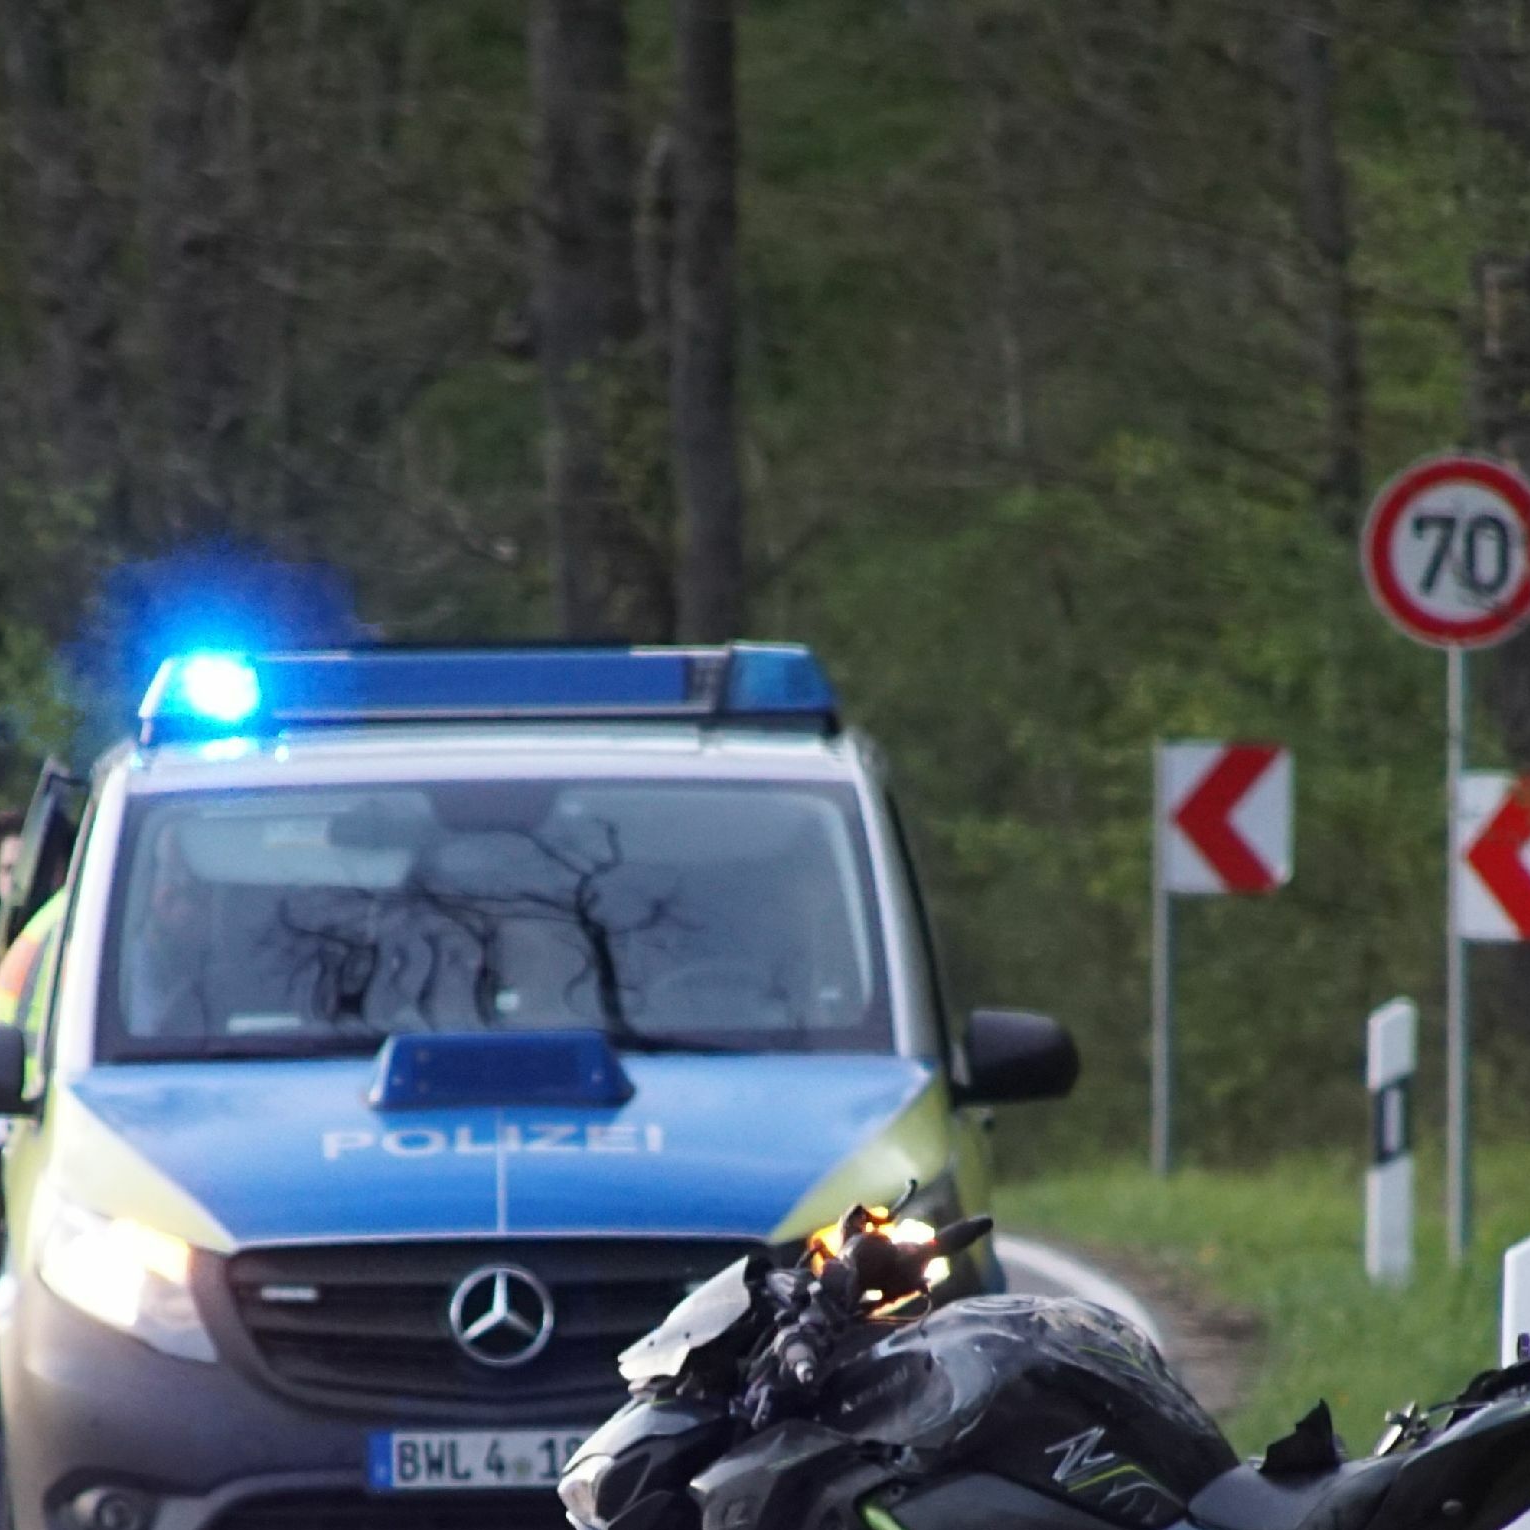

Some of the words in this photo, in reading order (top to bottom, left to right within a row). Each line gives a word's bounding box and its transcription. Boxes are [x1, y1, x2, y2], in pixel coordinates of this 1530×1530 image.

[1412, 513, 1510, 596] 70
[321, 1123, 663, 1160] POLIZEI
[398, 1439, 471, 1481] BWL
